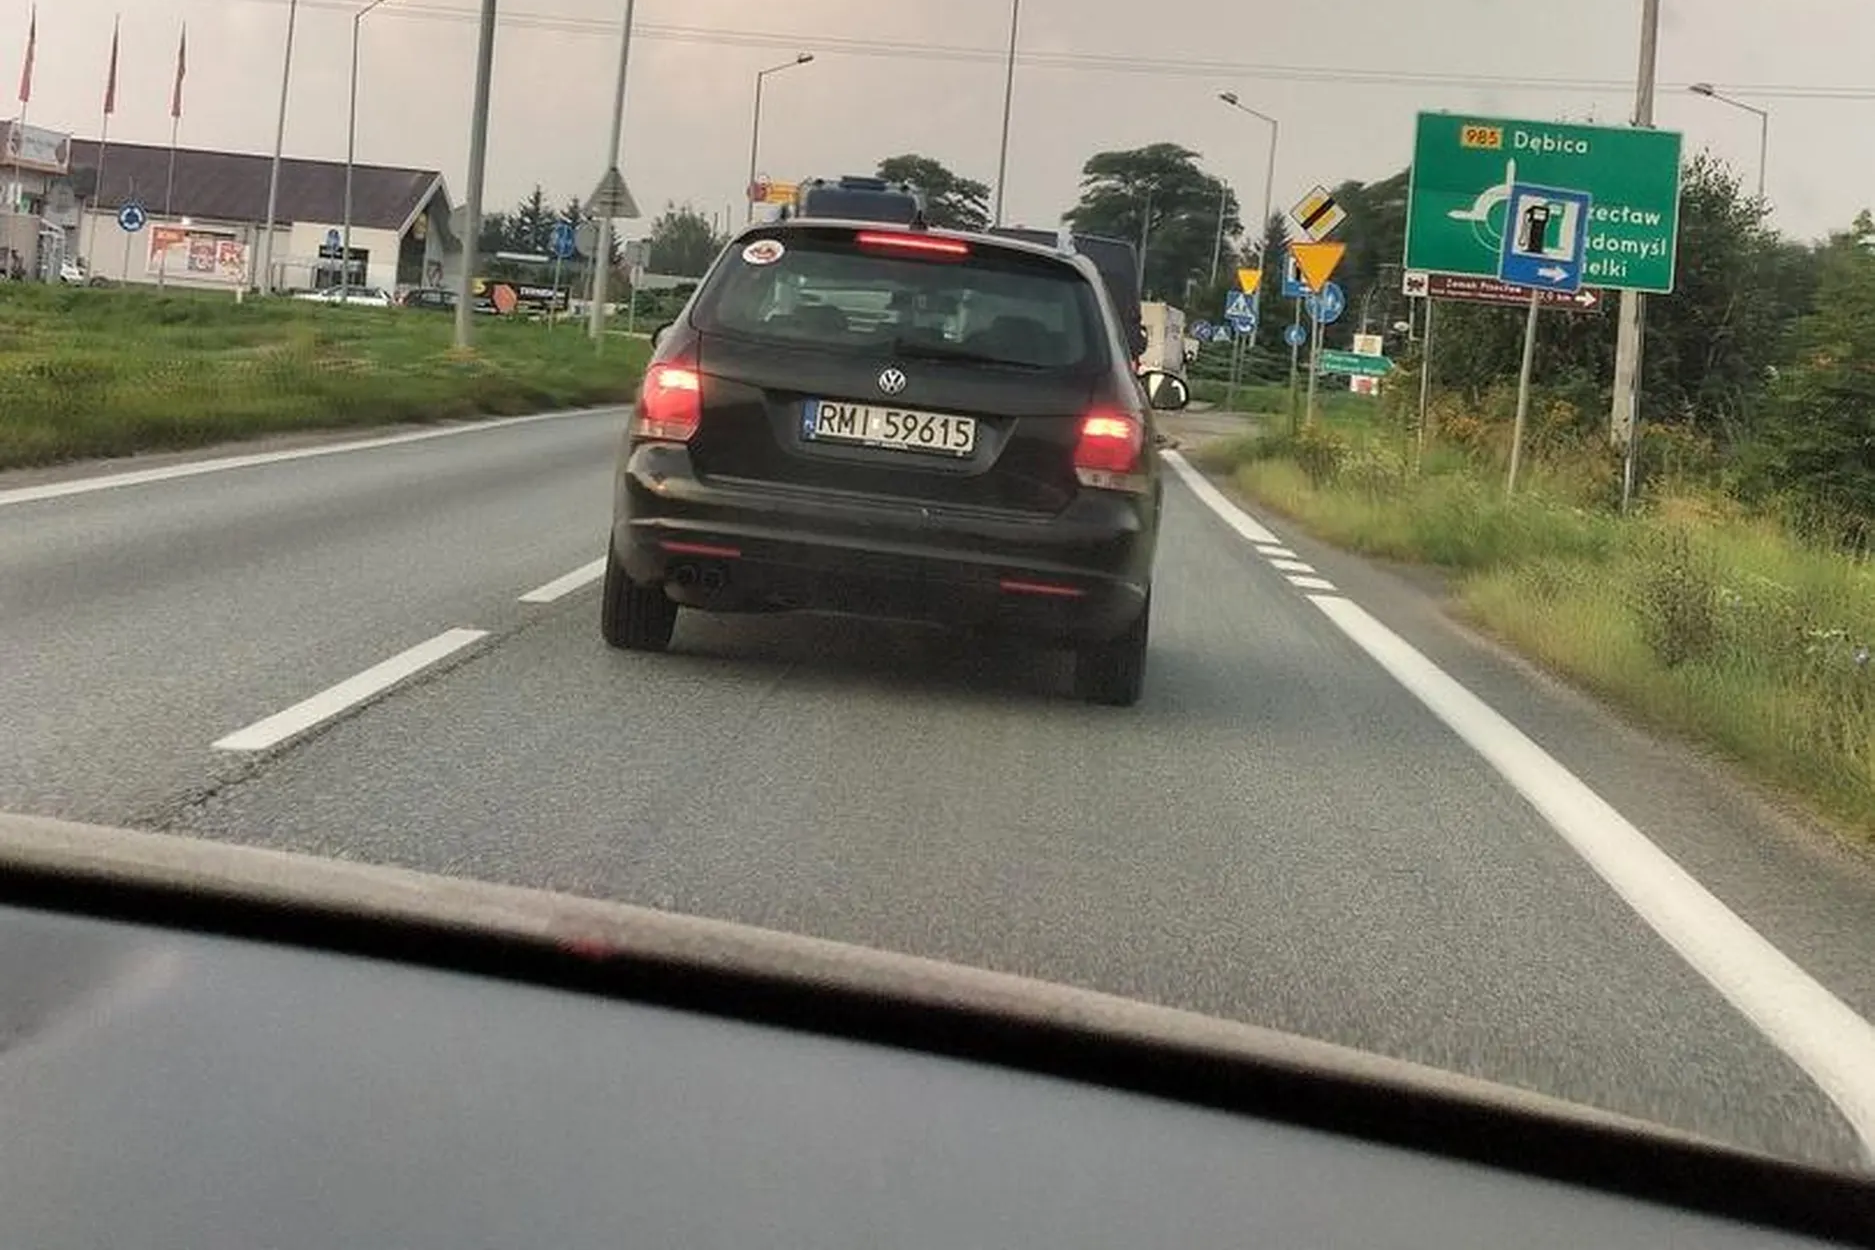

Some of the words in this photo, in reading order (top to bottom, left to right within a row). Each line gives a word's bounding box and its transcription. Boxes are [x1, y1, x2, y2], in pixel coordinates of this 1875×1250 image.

[1466, 129, 1498, 146] 985
[1514, 130, 1588, 156] Dębica
[1587, 206, 1660, 225] zecław
[1585, 232, 1667, 259] domyśl
[1582, 258, 1628, 277] ielki
[883, 411, 972, 448] 59615
